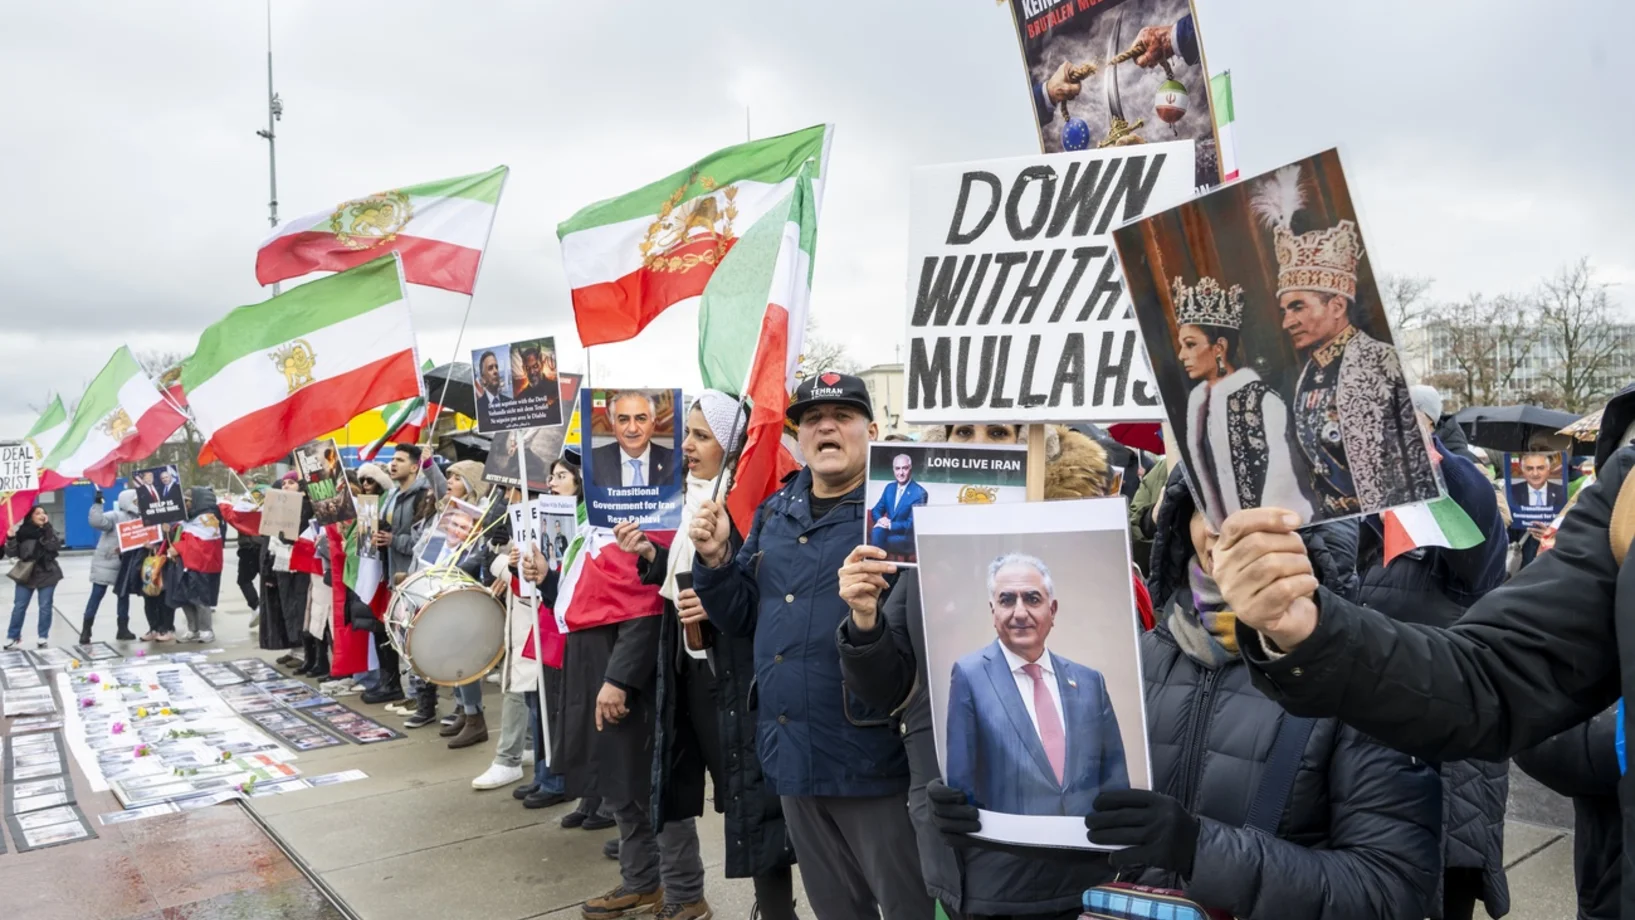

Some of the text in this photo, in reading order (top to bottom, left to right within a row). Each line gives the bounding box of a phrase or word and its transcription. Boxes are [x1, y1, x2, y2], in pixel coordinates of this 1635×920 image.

[1026, 1, 1075, 39] BRUTALEN
[945, 153, 1168, 245] DOWN
[911, 245, 1138, 327] WITH TH
[810, 387, 844, 397] TEHRAN
[2, 446, 34, 462] DEAL
[3, 460, 32, 475] THE
[927, 457, 1021, 471] LONG LIVE IRAN
[307, 478, 337, 502] IRAN
[607, 487, 659, 497] Transitional
[592, 500, 676, 510] Government for Iran
